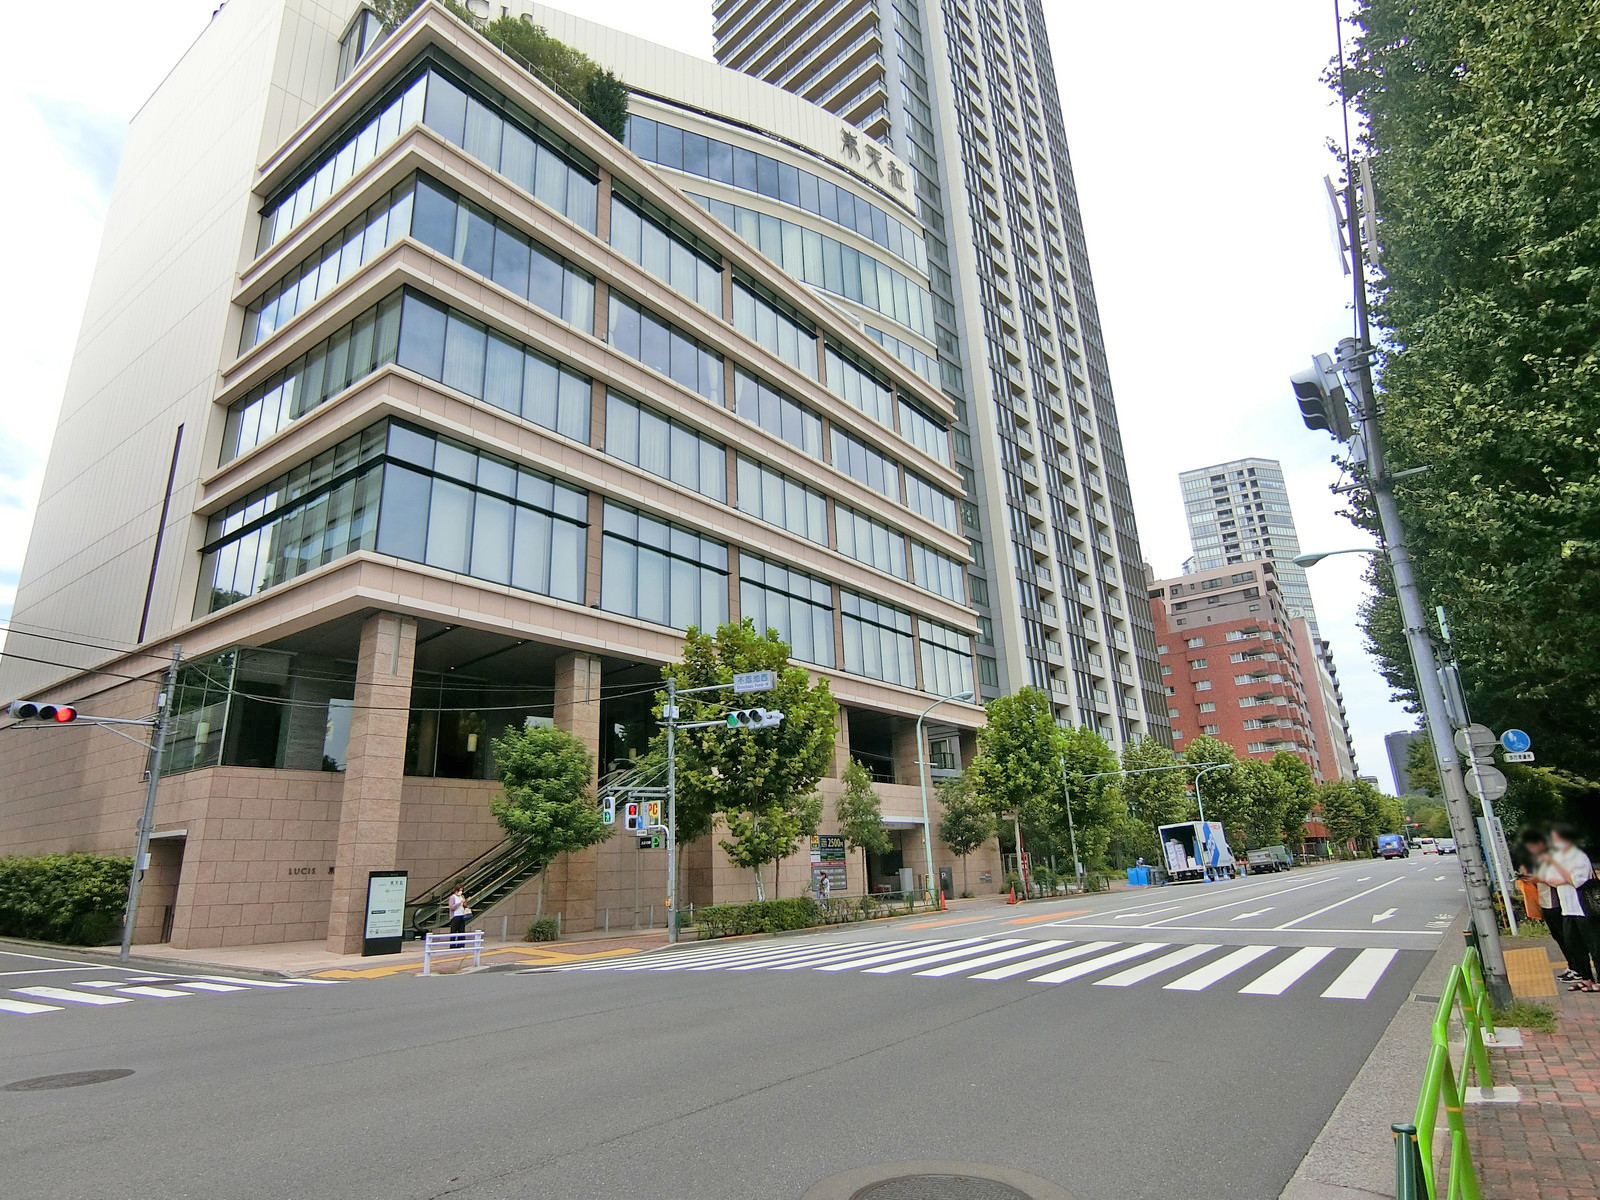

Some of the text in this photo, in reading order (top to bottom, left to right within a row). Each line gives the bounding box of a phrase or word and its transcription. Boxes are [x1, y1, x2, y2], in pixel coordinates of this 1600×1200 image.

[737, 673, 769, 684] 不忍池西
[288, 867, 316, 875] LUCIS
